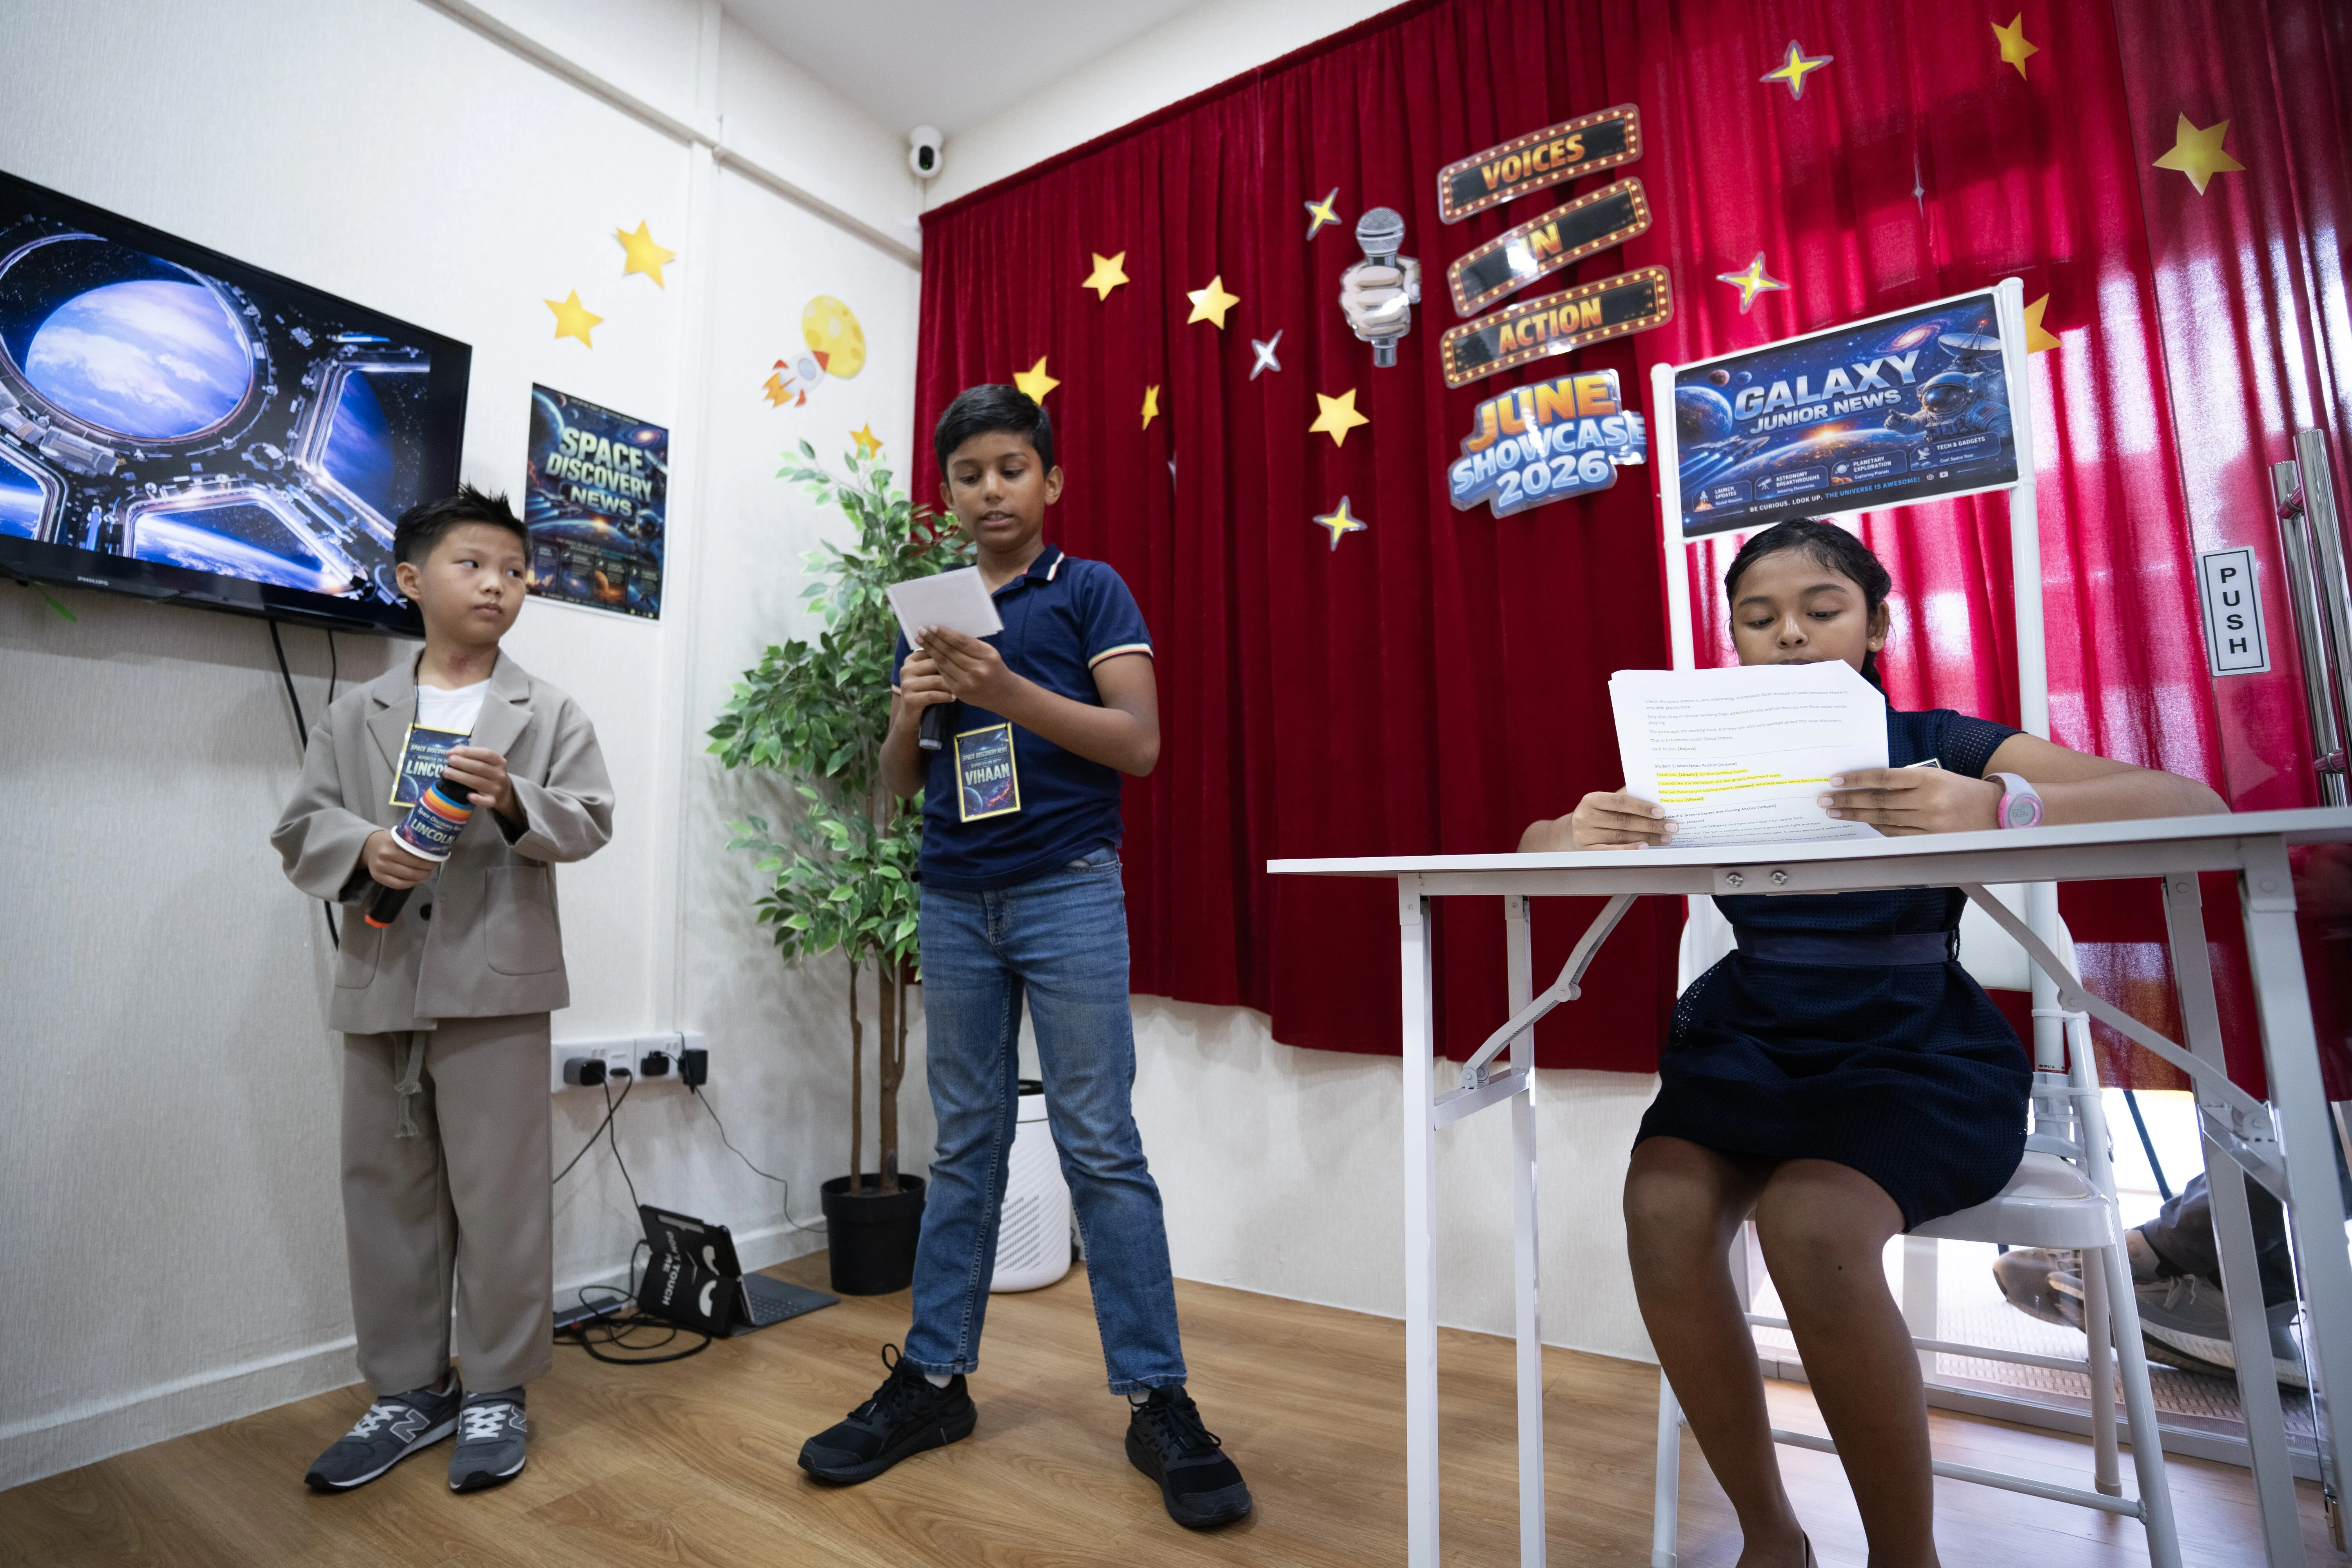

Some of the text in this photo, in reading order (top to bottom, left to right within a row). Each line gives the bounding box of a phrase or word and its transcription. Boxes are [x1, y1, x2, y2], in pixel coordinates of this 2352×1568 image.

[1481, 133, 1585, 191] VOICES
[1498, 296, 1603, 354] ACTION
[1735, 350, 1920, 421] GALAXY
[1468, 373, 1616, 452] JUNE
[1750, 389, 1902, 434] JUNIOR NEWS
[559, 426, 644, 477] SPACE
[1452, 416, 1647, 495] SHOWCASE
[1958, 436, 1985, 446] GADGETS
[545, 452, 653, 502] DISCOVERY
[1776, 471, 1808, 482] ASTRONOMY
[1853, 456, 1885, 467] PLANETARY
[1854, 461, 1892, 472] EXPLORATION
[1497, 450, 1609, 508] 2026
[1715, 486, 1734, 495] LAUNCH
[1715, 490, 1737, 500] UPDATES
[1760, 501, 1790, 511] CURIOUS.
[1792, 497, 1810, 505] LOOK
[1840, 485, 1873, 496] UNIVERSE
[1883, 476, 1920, 489] AWESOME!
[1776, 474, 1820, 488] BREAKTHROUGHS
[570, 486, 633, 518] NEWS
[77, 576, 109, 586] PHILIPS
[2220, 567, 2247, 654] PUSH
[405, 760, 448, 779] LINCO
[976, 748, 997, 759] DISCOVERY
[965, 763, 1010, 785] VIHAAN
[417, 807, 430, 818] Space
[410, 818, 456, 844] LINCOLN
[662, 1264, 681, 1306] TOUCH
[390, 1408, 431, 1443] N
